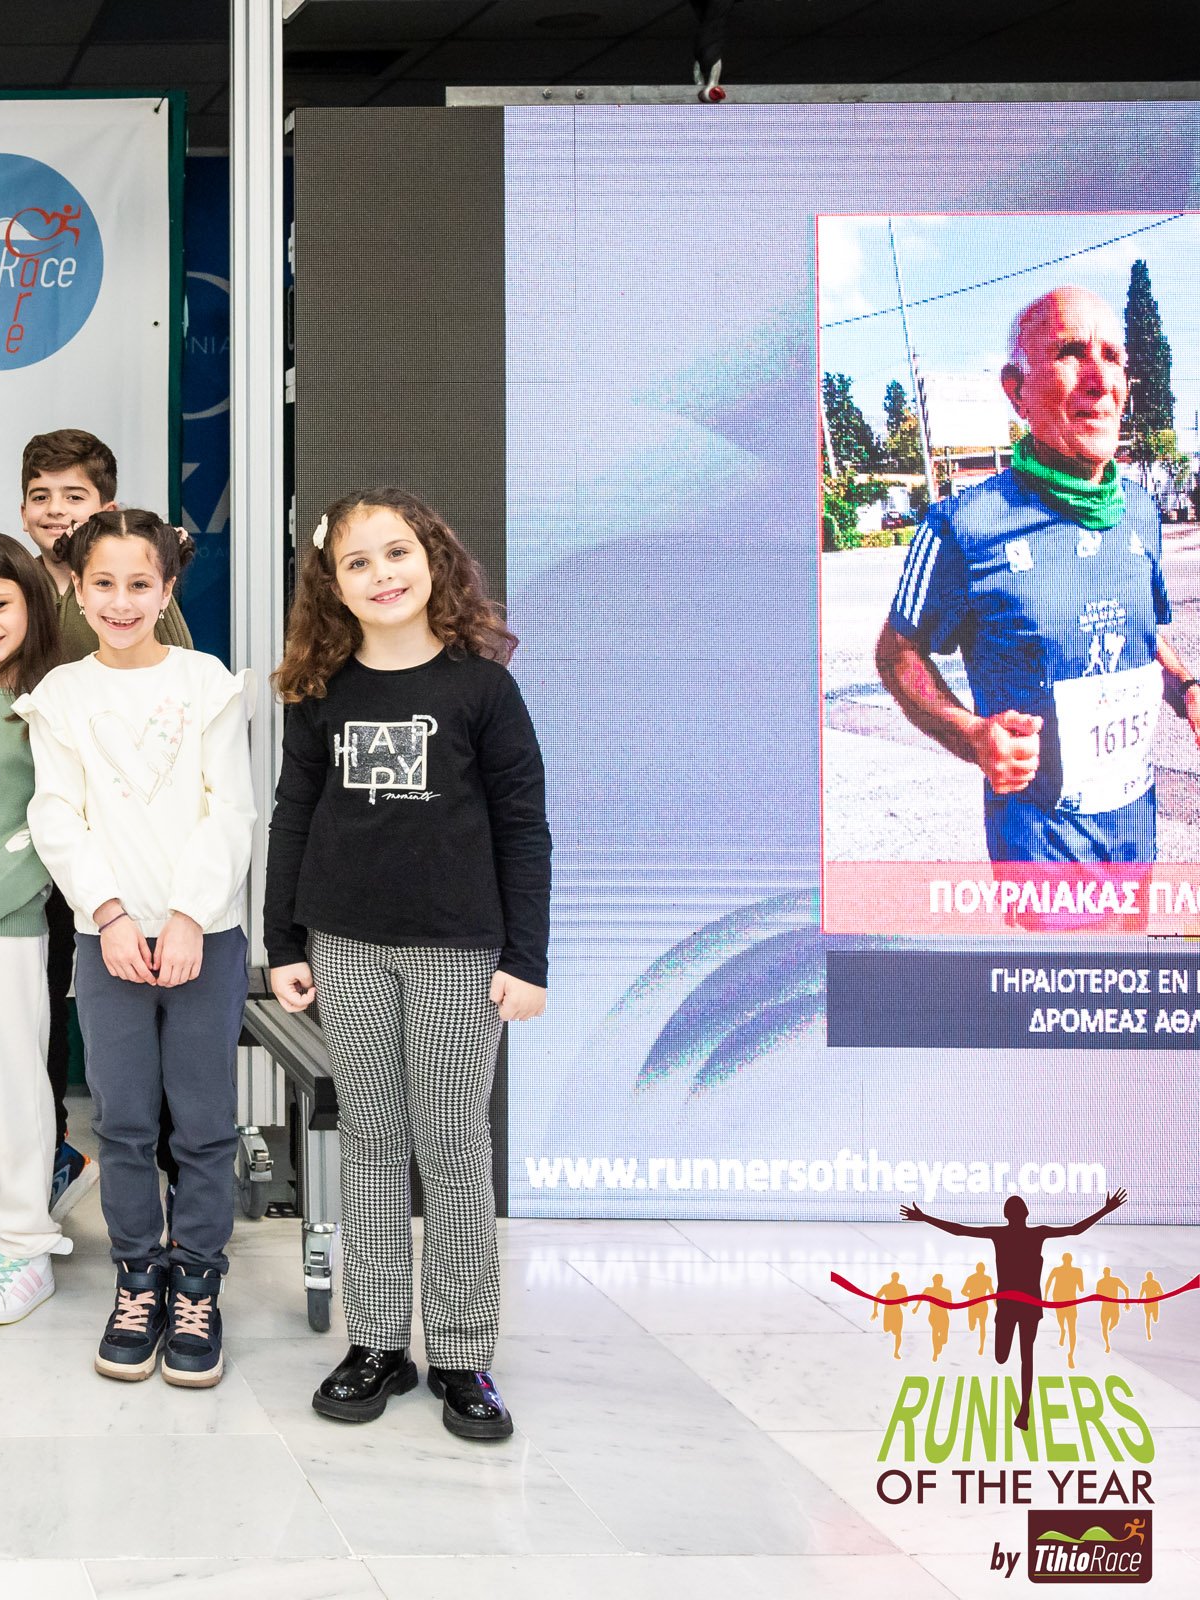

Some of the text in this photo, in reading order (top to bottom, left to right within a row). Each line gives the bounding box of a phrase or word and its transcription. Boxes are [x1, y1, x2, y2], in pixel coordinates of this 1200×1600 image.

[381, 790, 441, 802] moments
[1149, 882, 1200, 914] ΠΛ
[990, 968, 1151, 994] ΓΗΡΑΙΟΤΕΡΟΣ
[1028, 1008, 1148, 1034] ΔΡΟΜΕΑΣ
[525, 1149, 1106, 1202] www.runnersoftheyear.com
